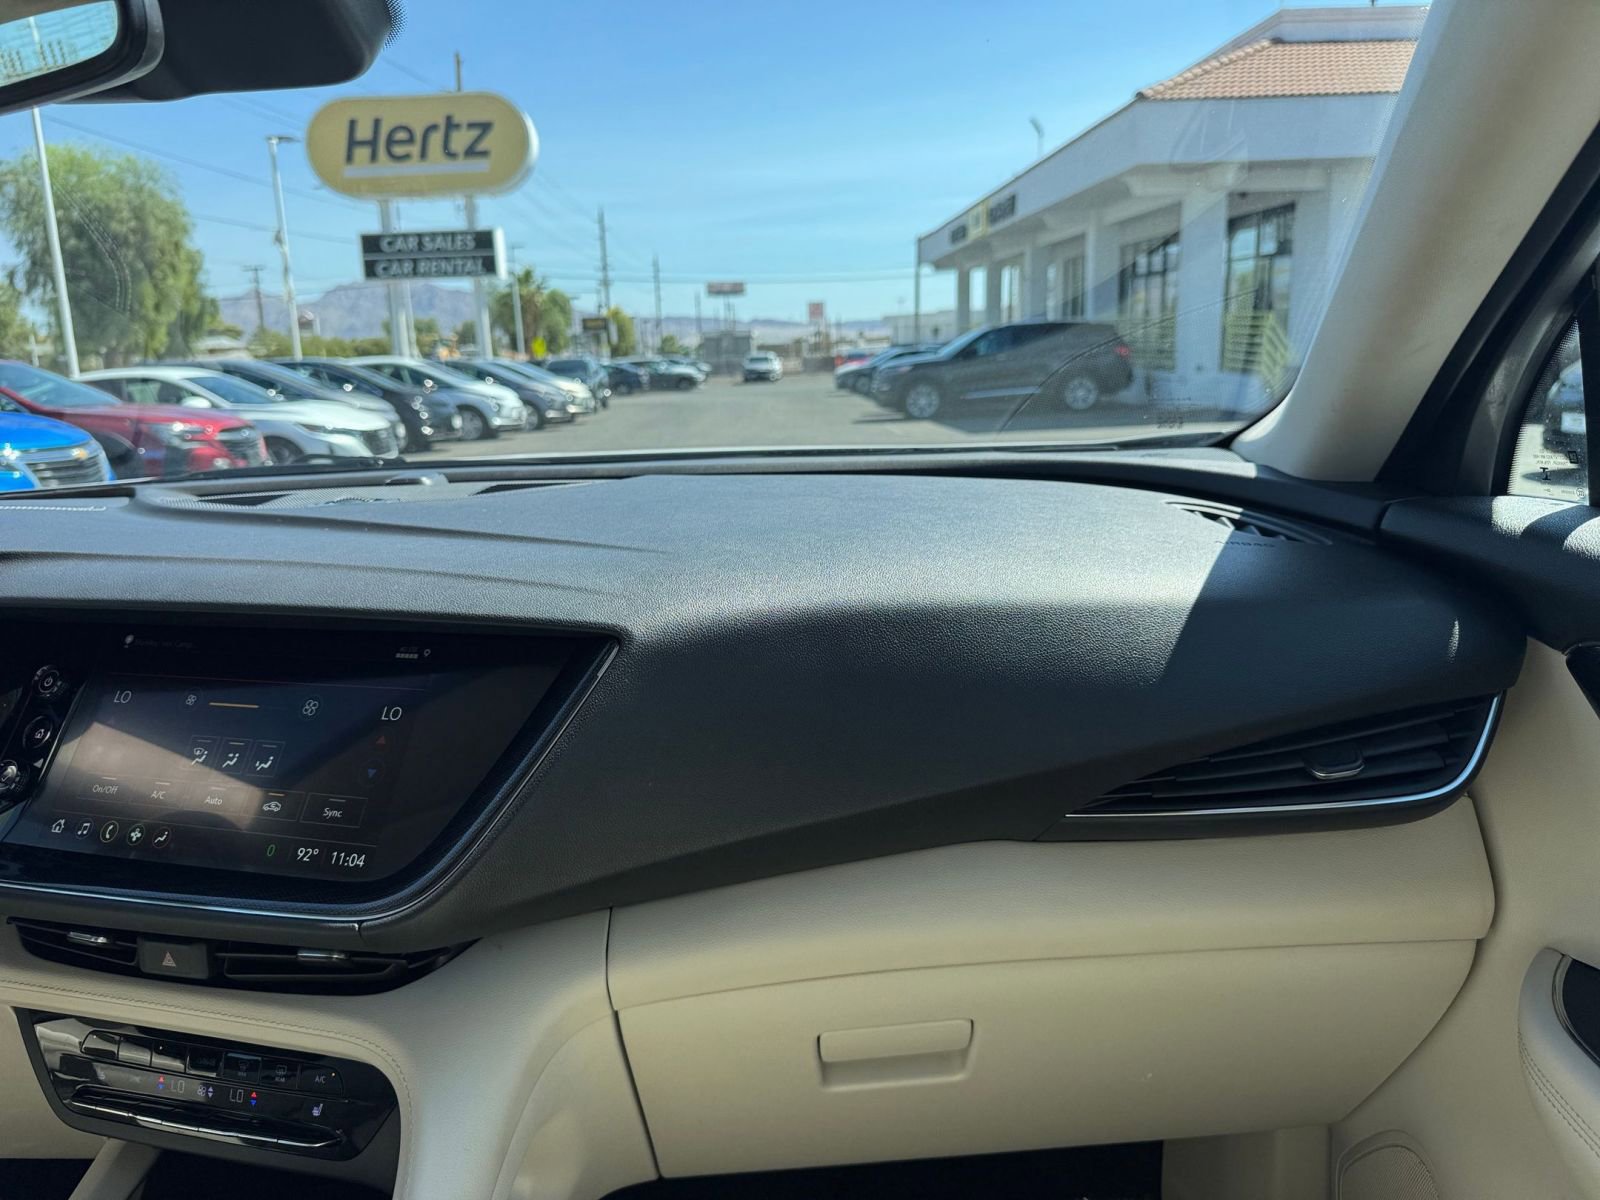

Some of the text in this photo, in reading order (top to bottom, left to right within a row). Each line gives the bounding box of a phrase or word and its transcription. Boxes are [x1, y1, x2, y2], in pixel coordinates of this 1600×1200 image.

[345, 114, 494, 165] Hertz
[380, 232, 476, 253] CAR SALES
[375, 256, 486, 277] CAR RENTAL
[113, 690, 132, 704] LO
[380, 705, 402, 721] LO
[92, 784, 119, 795] On/Off
[151, 790, 167, 800] A/C
[205, 795, 223, 806] Auto
[322, 807, 343, 819] Sync
[296, 847, 319, 862] 92°
[331, 851, 366, 868] 11:04
[314, 1075, 327, 1084] A/C
[171, 1080, 185, 1094] LO
[230, 1088, 244, 1103] LO
